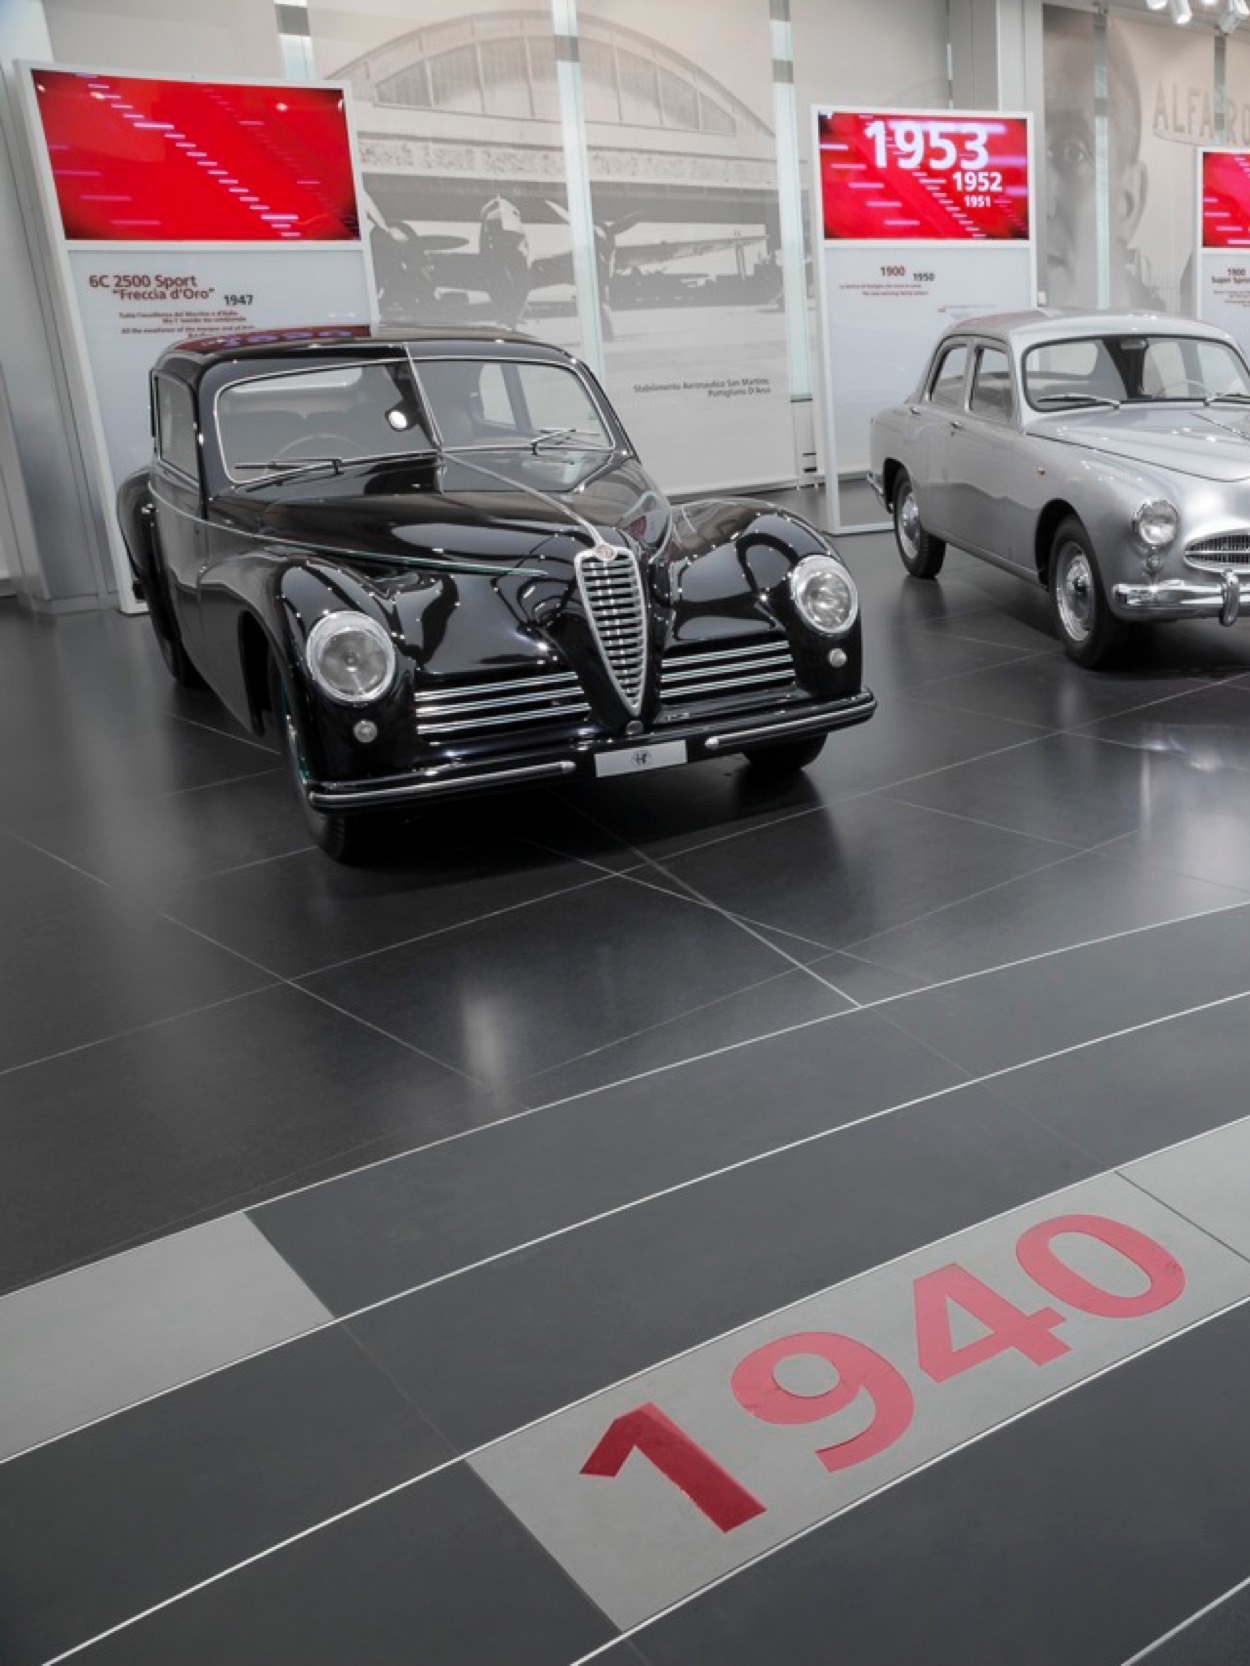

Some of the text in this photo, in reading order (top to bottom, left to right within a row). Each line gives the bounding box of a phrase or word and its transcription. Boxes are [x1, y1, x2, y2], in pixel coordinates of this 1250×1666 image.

[1153, 78, 1213, 139] ALFA
[865, 120, 989, 170] 1953
[952, 171, 1003, 192] 1952
[964, 195, 991, 208] 1951
[880, 265, 906, 277] 1900
[89, 274, 198, 290] 6C 2500 Sport
[223, 294, 254, 306] 1947
[579, 1213, 1187, 1534] 1940
